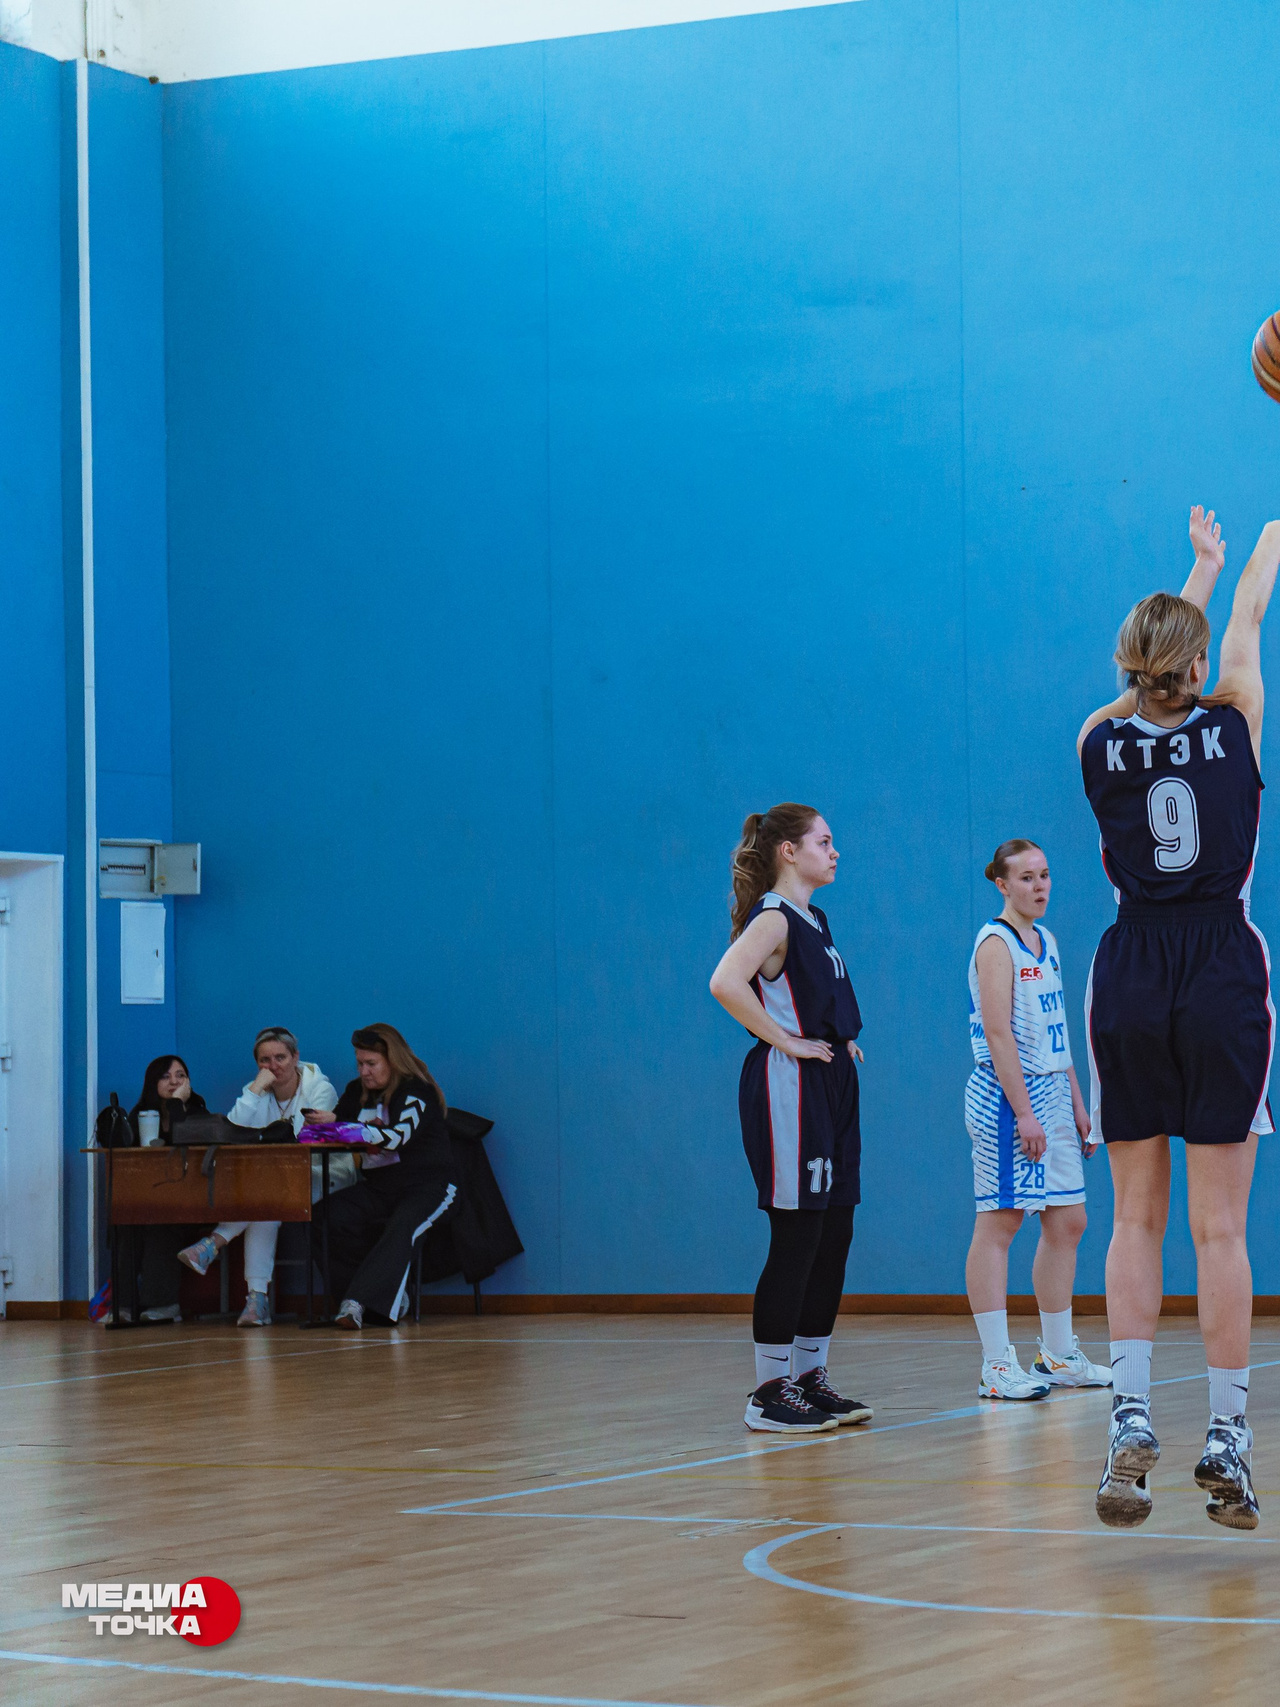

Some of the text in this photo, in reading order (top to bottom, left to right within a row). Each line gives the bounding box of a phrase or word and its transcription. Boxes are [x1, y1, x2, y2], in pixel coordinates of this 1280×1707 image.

[1106, 726, 1226, 772] КТЭК
[1146, 776, 1200, 873] 9
[1019, 1162, 1045, 1189] 28
